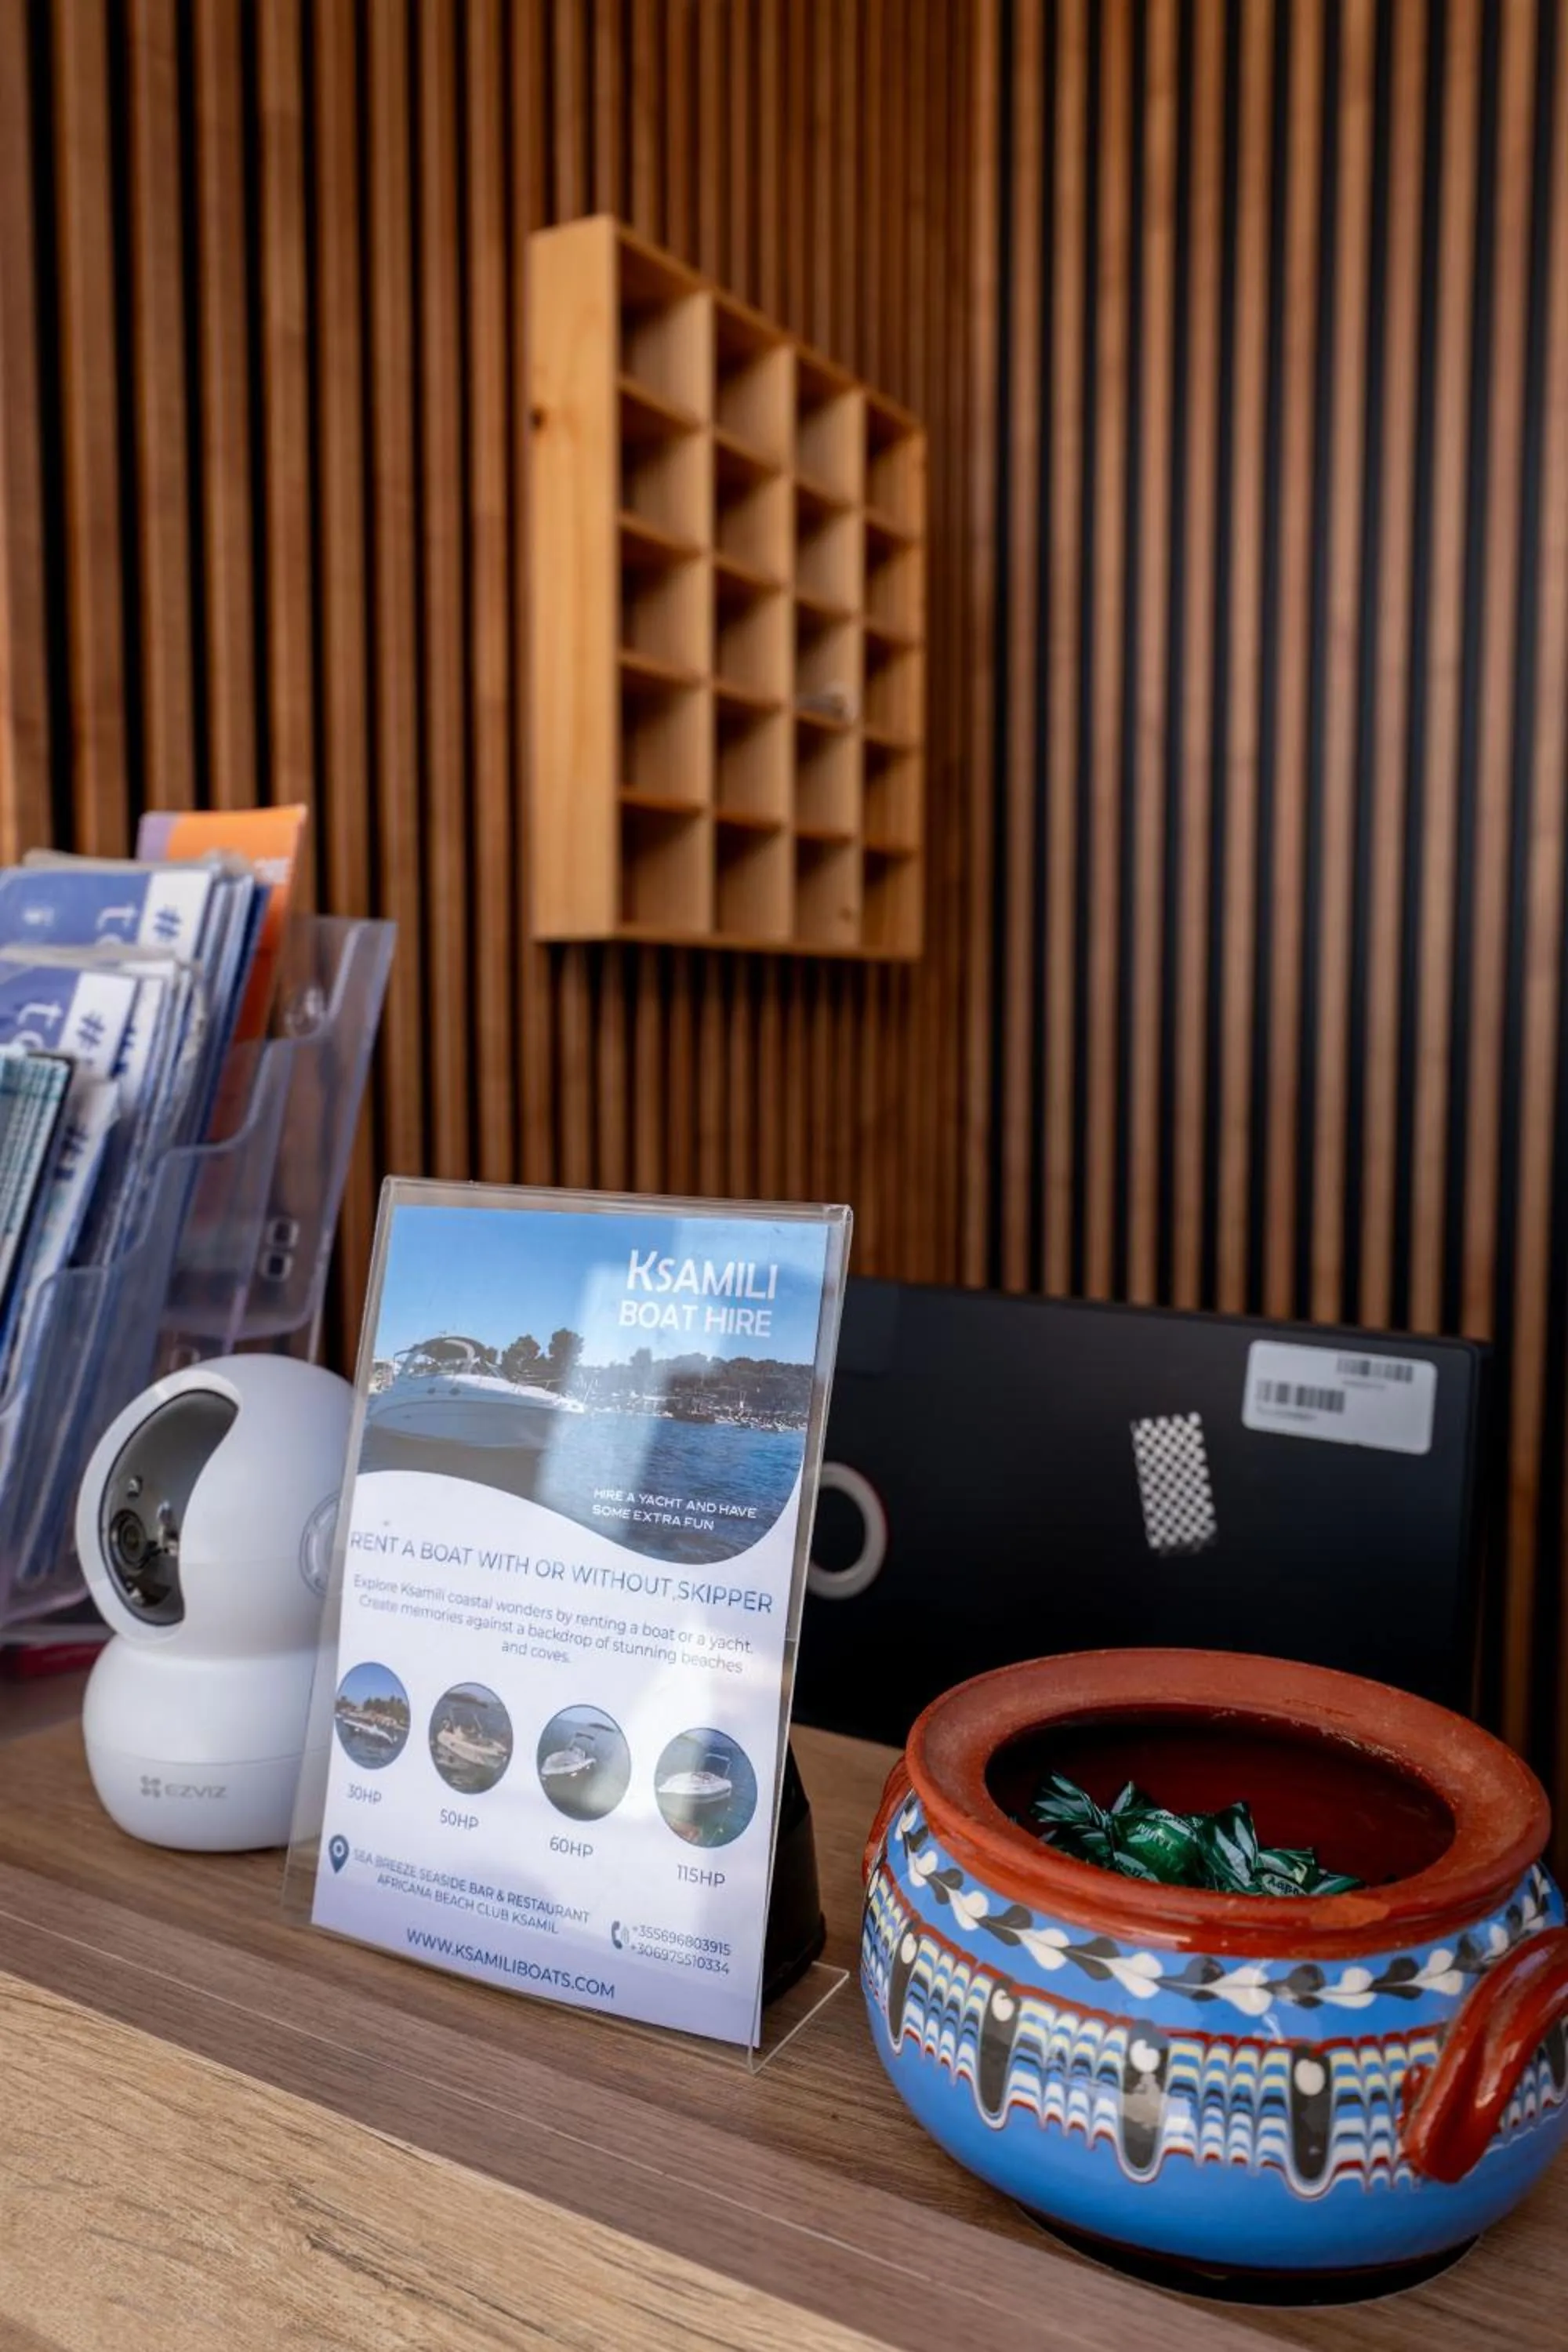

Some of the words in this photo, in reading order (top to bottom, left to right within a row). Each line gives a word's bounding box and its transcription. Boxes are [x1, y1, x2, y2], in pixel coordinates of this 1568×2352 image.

[626, 1249, 779, 1299] KSAMILI
[618, 1300, 699, 1330] BOAT
[704, 1305, 772, 1338] HIRE
[592, 1504, 630, 1519] SOME
[633, 1509, 681, 1528] EXTRA
[683, 1518, 714, 1531] FUN
[593, 1488, 623, 1502] HIRE
[626, 1490, 635, 1503] A
[638, 1493, 682, 1509] YACHT
[686, 1501, 717, 1513] AND
[719, 1504, 757, 1519] HAVE
[350, 1530, 398, 1553] RENT
[402, 1540, 416, 1558] A
[420, 1543, 473, 1566] BOAT
[478, 1551, 529, 1574] WITH
[535, 1559, 565, 1581] OR
[572, 1565, 673, 1597] WITHOUT
[677, 1581, 773, 1613] SKIPPER
[354, 1574, 398, 1594] Explore
[401, 1581, 445, 1601] Ksamili
[448, 1590, 493, 1610] coastal
[495, 1601, 553, 1621] wonders
[556, 1608, 572, 1626] by
[575, 1613, 626, 1635] renting
[630, 1624, 638, 1635] a
[642, 1623, 674, 1641] boat
[678, 1630, 693, 1641] or
[696, 1634, 706, 1646] a
[709, 1635, 753, 1654] yacht.
[358, 1594, 398, 1613] Create
[401, 1604, 463, 1625] memories
[466, 1615, 513, 1635] against
[516, 1624, 524, 1635] a
[528, 1624, 592, 1647] backdrop
[595, 1635, 608, 1649] of
[613, 1640, 677, 1664] stunning
[681, 1650, 743, 1674] beaches
[502, 1640, 528, 1656] and
[531, 1646, 571, 1664] coves.
[165, 1783, 227, 1799] EZVIZ
[346, 1784, 382, 1804] 30HP
[439, 1808, 480, 1829] 50HP
[550, 1835, 593, 1858] 60HP
[354, 1848, 372, 1864] SEA
[375, 1855, 416, 1878] BREEZE
[419, 1867, 466, 1892] SEASIDE
[470, 1882, 494, 1901] BAR
[496, 1889, 504, 1903] &
[507, 1891, 590, 1924] RESTAURANT
[677, 1864, 725, 1889] 115HP
[377, 1873, 431, 1898] AFRICANA
[434, 1890, 474, 1911] BEACH
[477, 1902, 509, 1921] CLUB
[513, 1911, 558, 1934] KSAMIL
[407, 1928, 615, 1998] WWW.KSAMILIBOATS.COM
